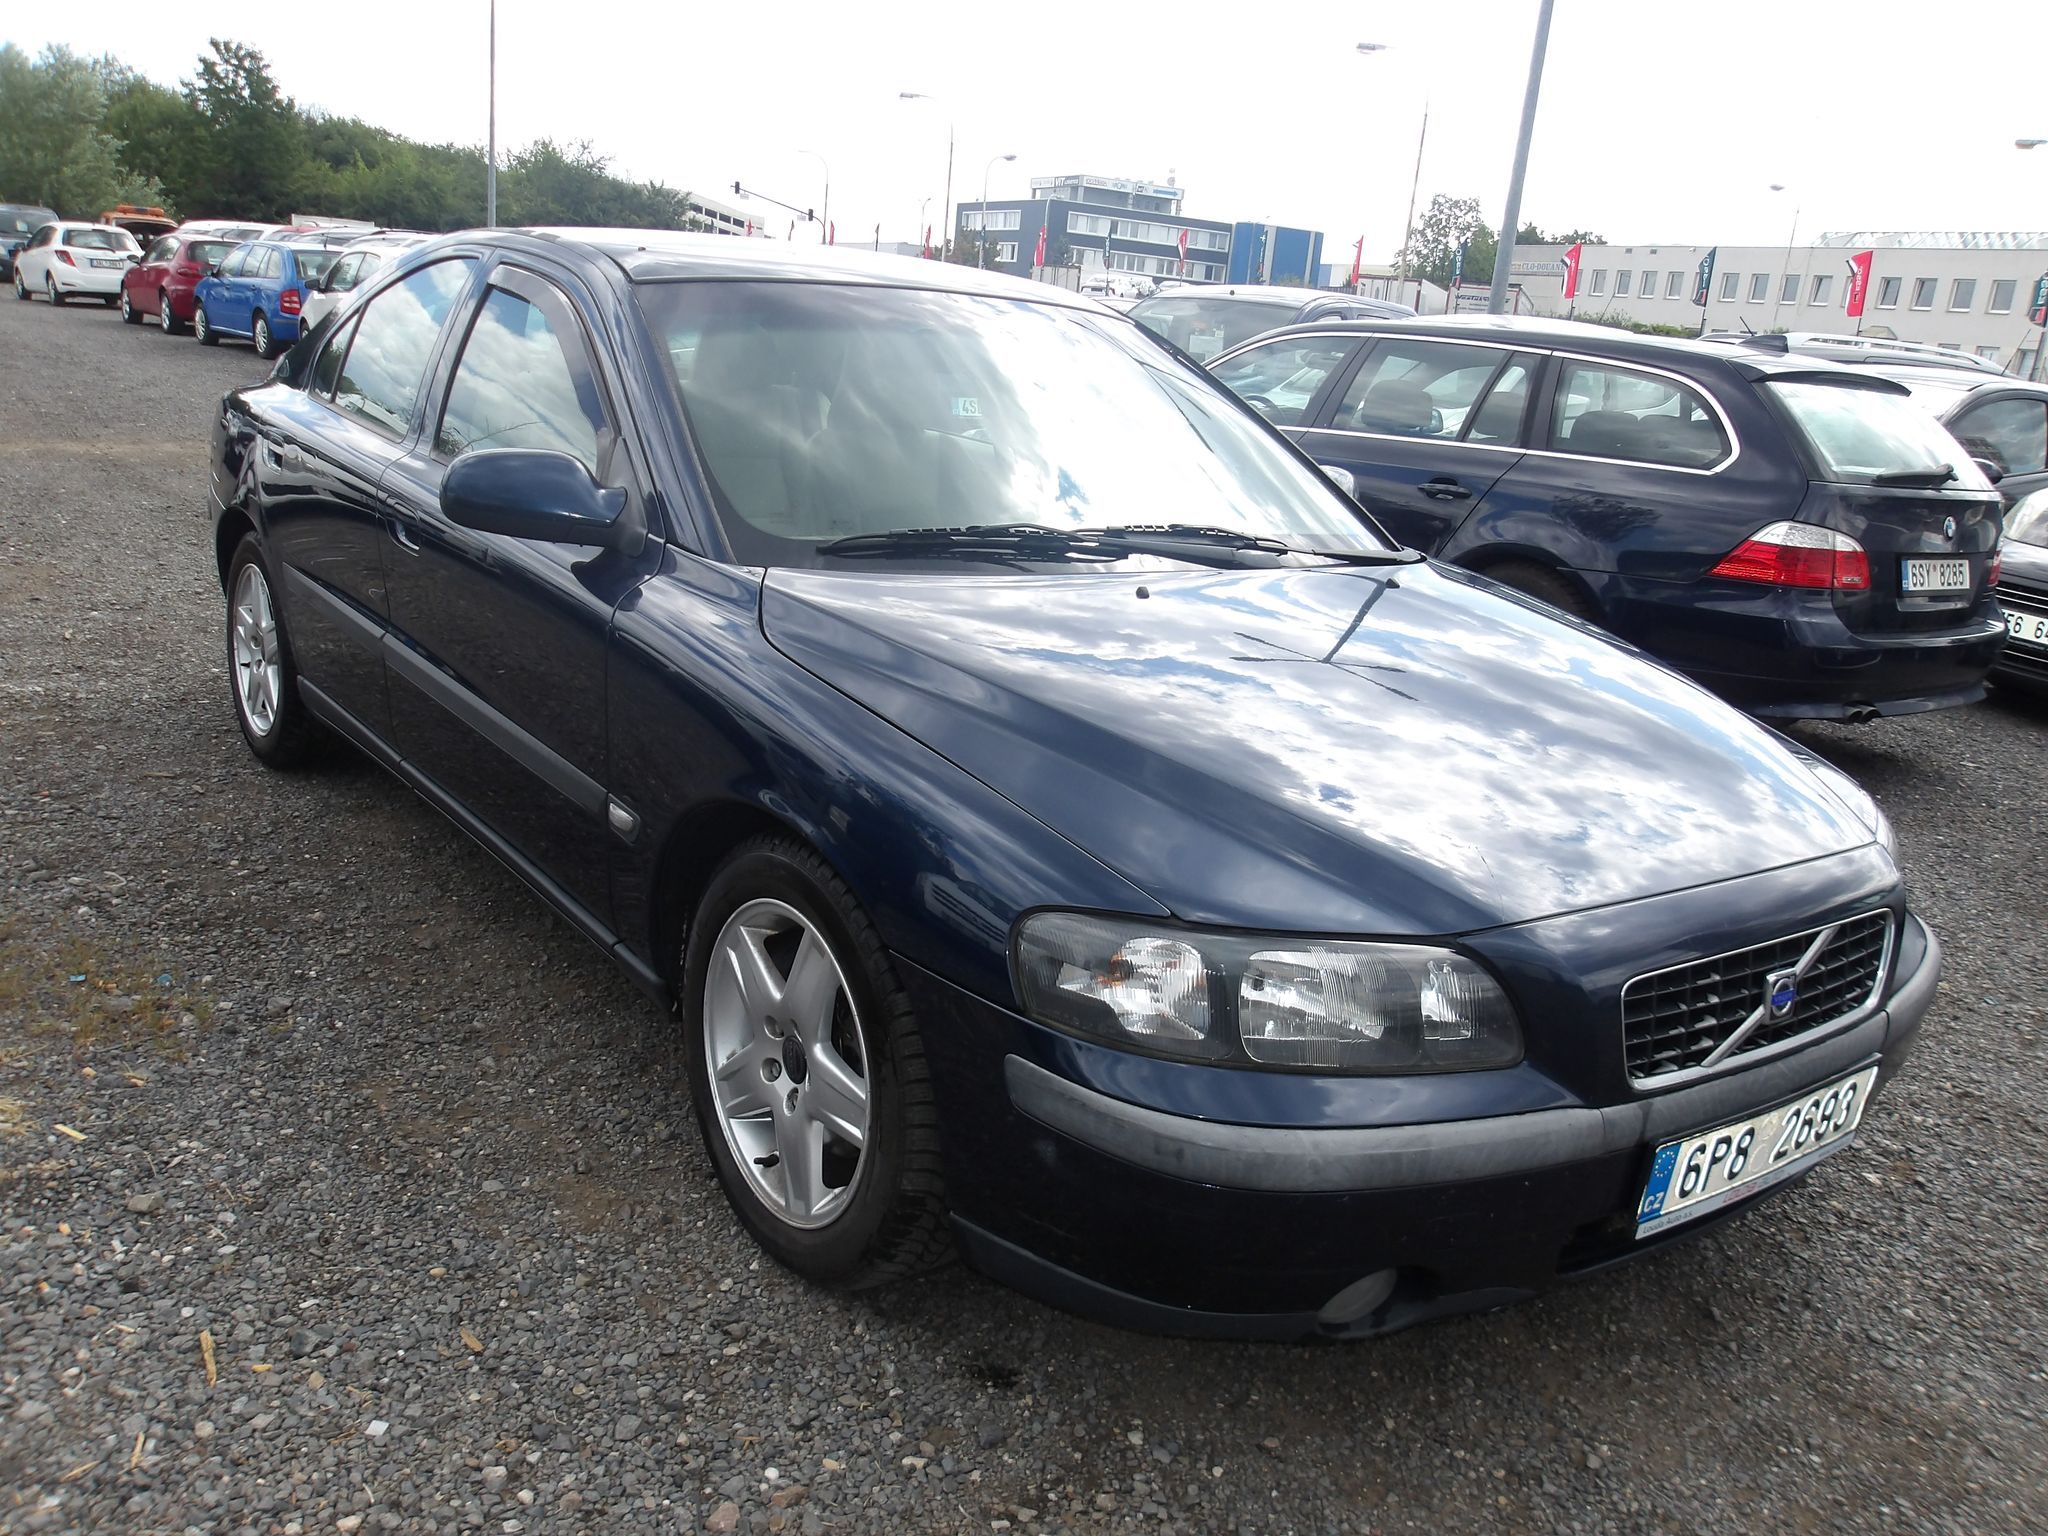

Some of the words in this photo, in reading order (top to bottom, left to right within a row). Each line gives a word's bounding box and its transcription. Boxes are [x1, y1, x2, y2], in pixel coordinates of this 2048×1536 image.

[1911, 563, 1931, 587] 6SY
[1939, 563, 1964, 587] 8285
[1675, 1126, 1756, 1199] 6P8
[1769, 1081, 1858, 1164] 2693
[1643, 1191, 1665, 1213] CZ
